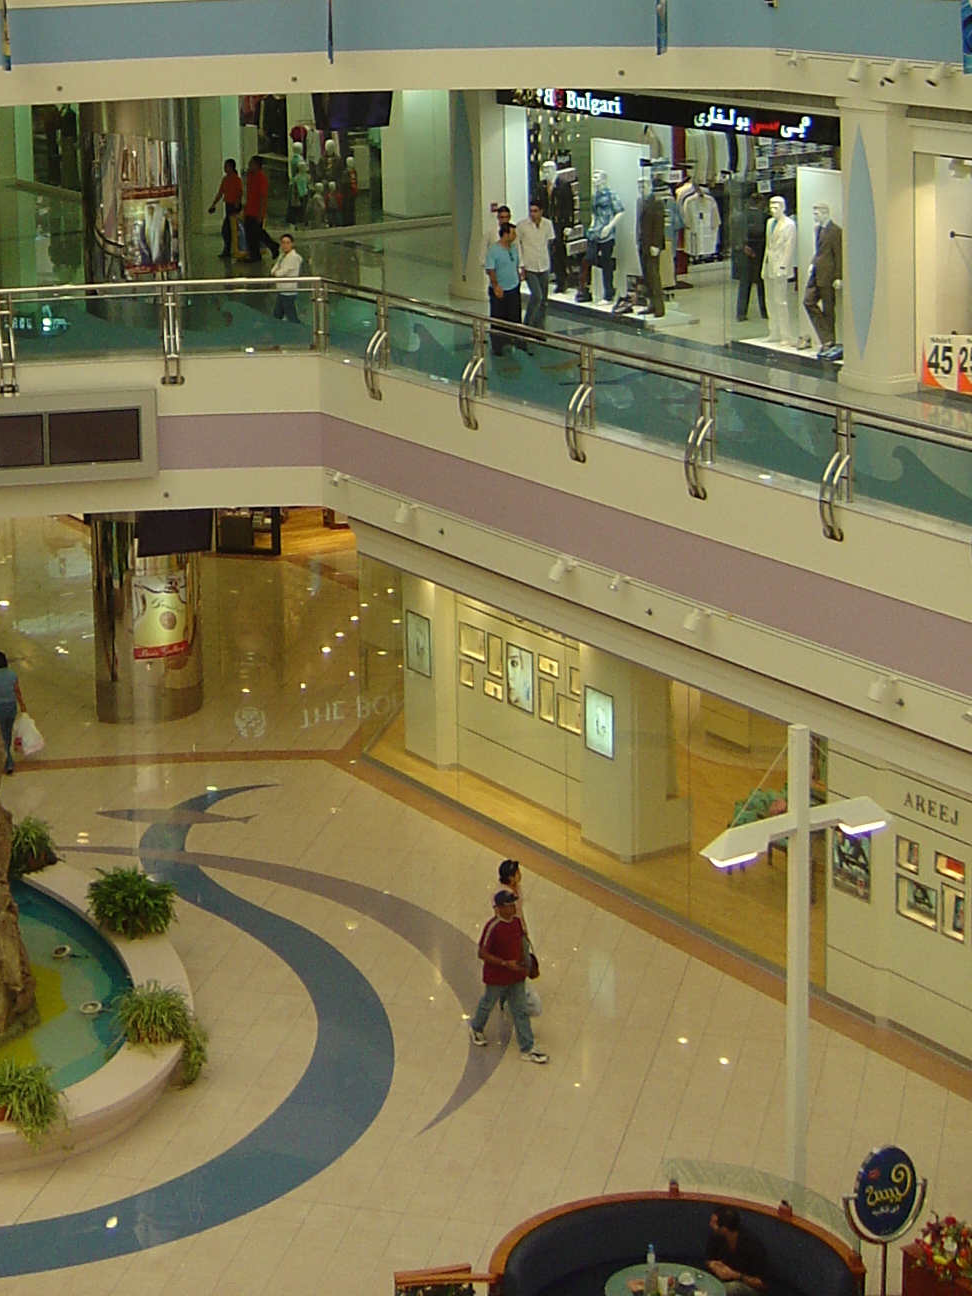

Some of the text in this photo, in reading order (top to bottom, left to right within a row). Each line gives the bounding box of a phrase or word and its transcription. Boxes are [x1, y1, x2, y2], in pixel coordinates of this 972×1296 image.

[566, 90, 622, 116] Bulgari
[927, 345, 953, 374] 45
[903, 792, 959, 825] AREEJ
